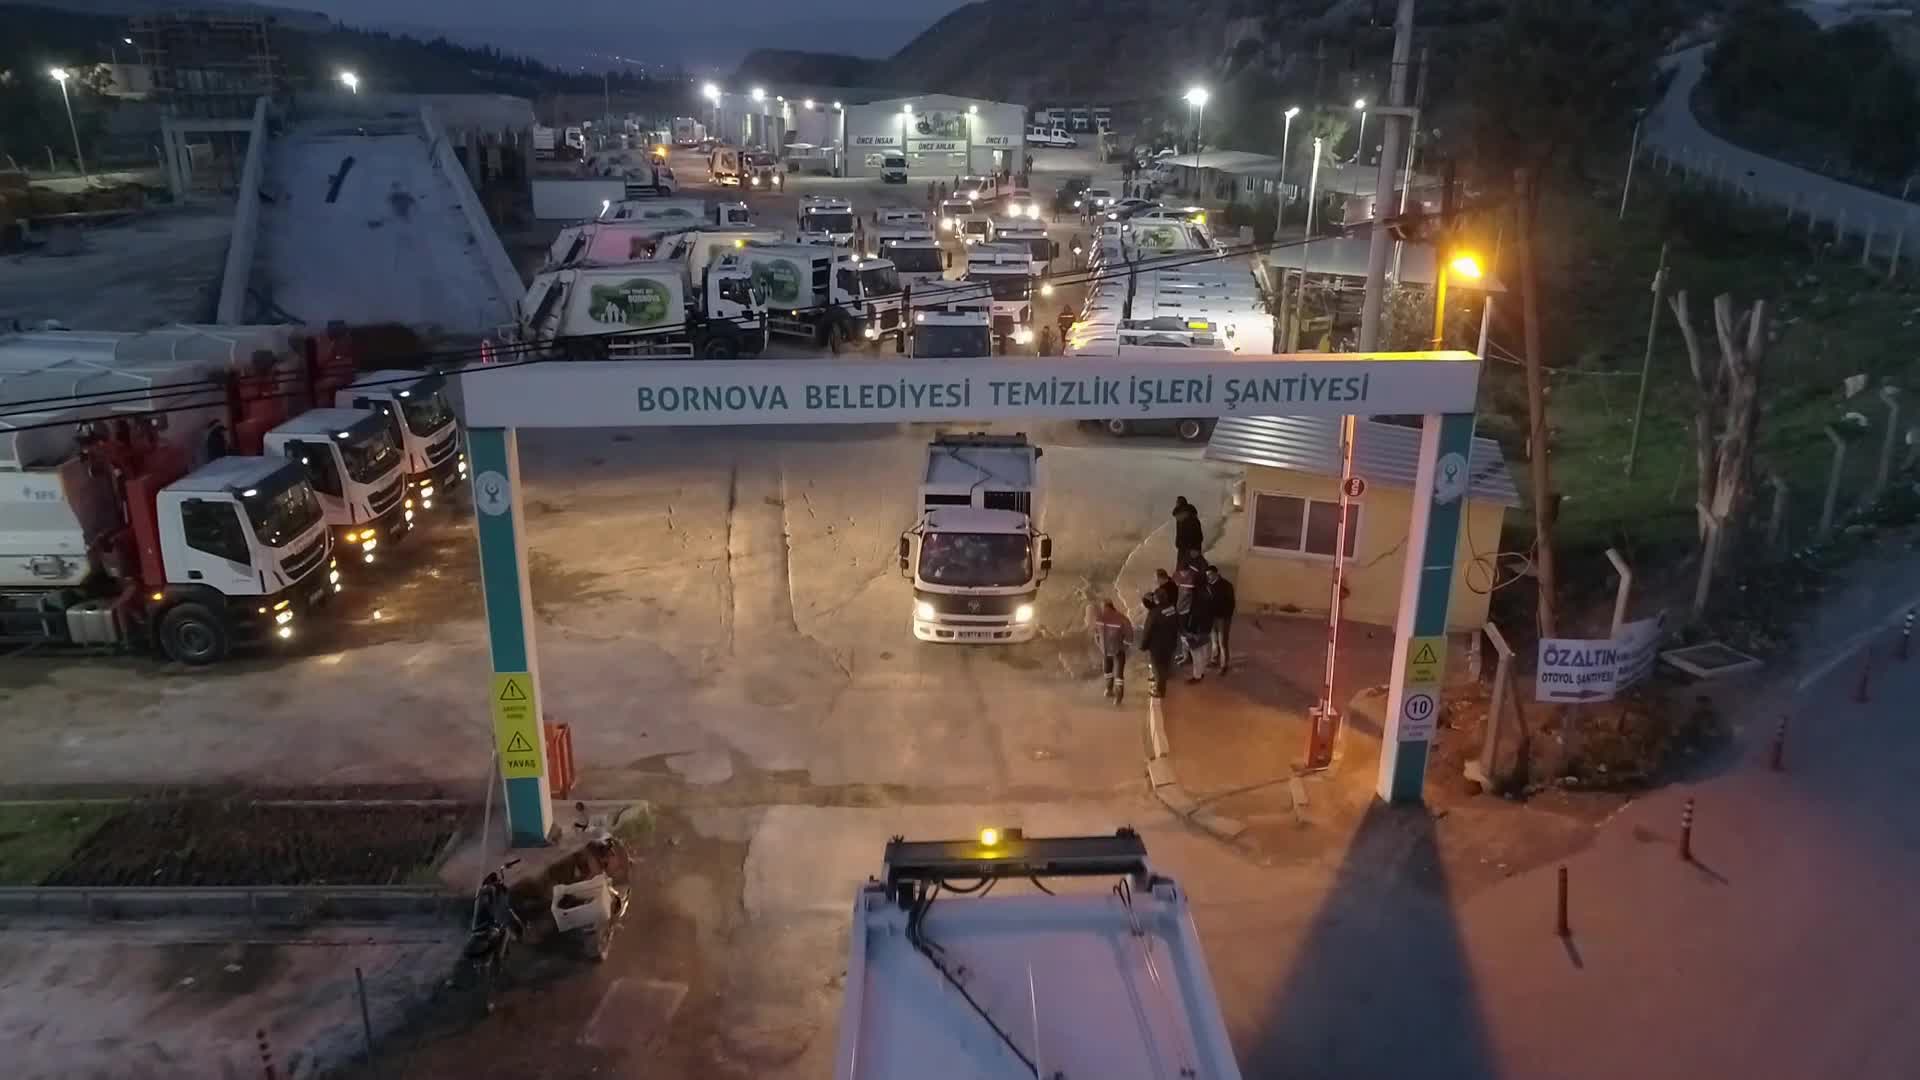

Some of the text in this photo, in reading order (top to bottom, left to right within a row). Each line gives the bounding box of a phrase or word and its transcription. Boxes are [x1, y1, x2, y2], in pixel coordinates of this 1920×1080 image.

[856, 135, 894, 144] ÖNCE İNSAN
[986, 136, 1001, 144] ÖNCE
[918, 142, 935, 150] ÖNCE
[637, 373, 1370, 412] BORNOVA BELEDİYESİ TEMİZLİK İŞLERİ ŞANTİYESİ
[1543, 643, 1617, 668] ÖZALTIN
[1541, 672, 1574, 684] OTOYOL
[1412, 700, 1428, 714] 10
[507, 759, 536, 769] YAVAŞ
